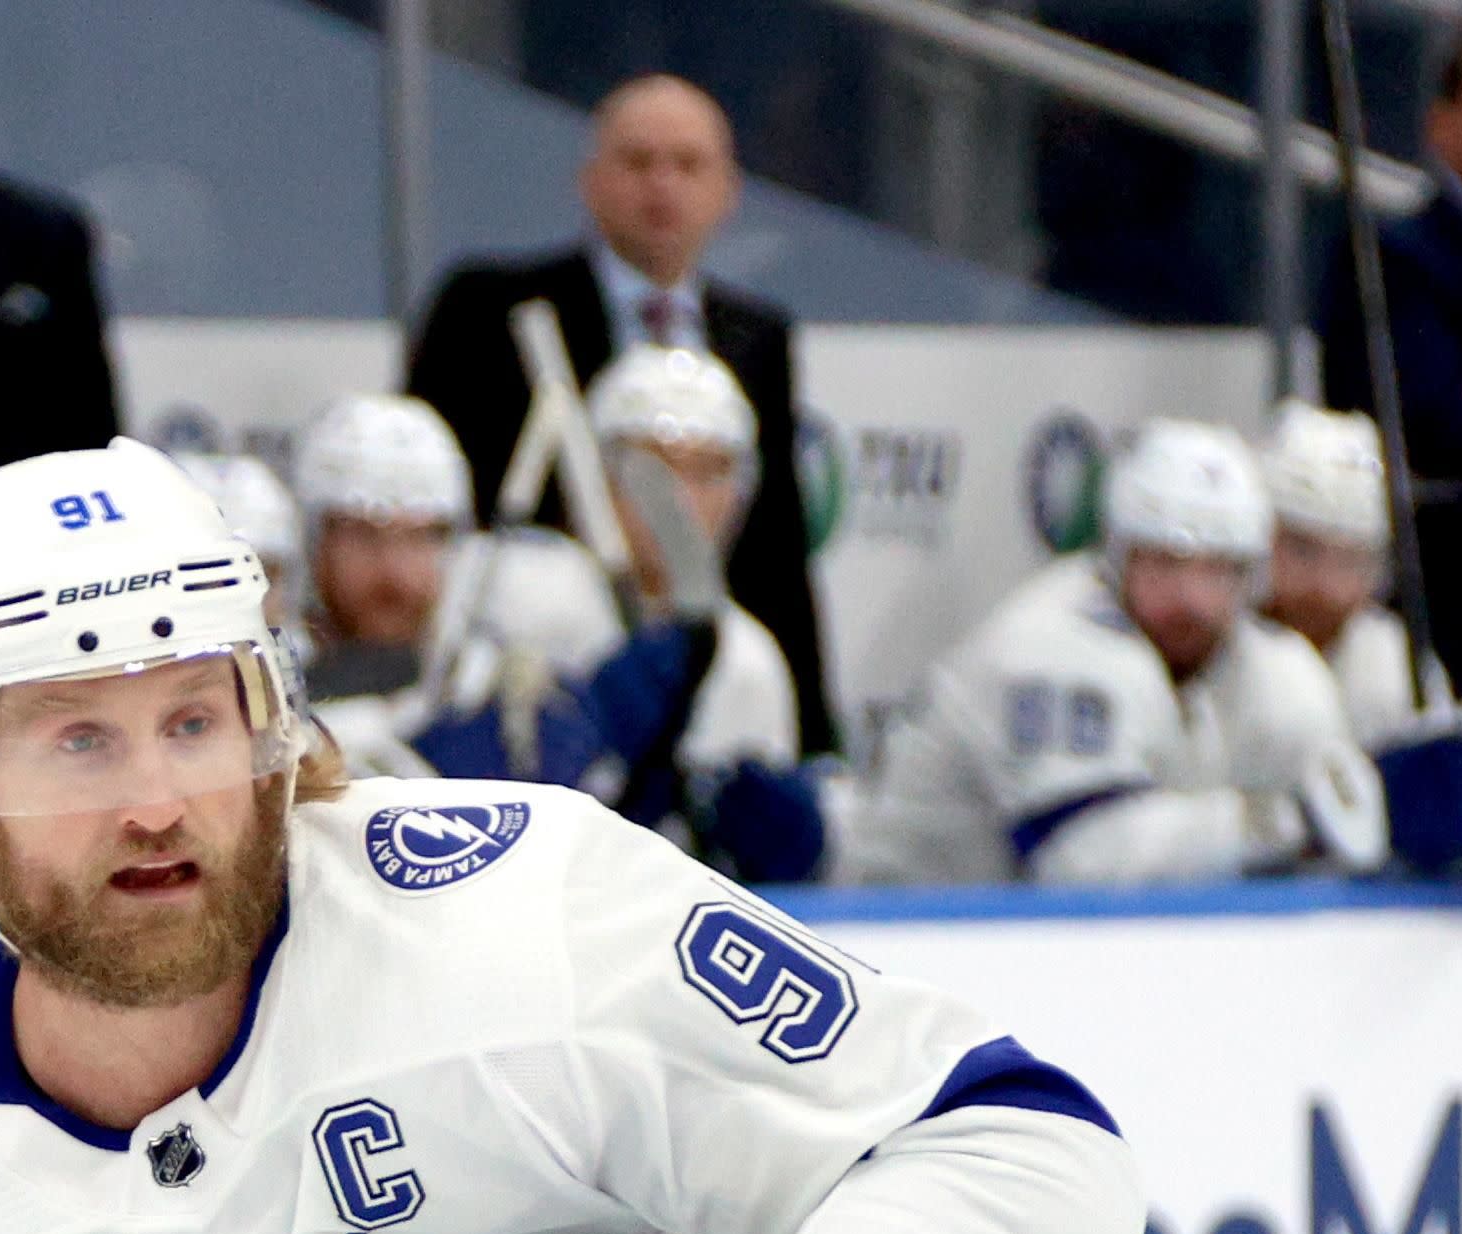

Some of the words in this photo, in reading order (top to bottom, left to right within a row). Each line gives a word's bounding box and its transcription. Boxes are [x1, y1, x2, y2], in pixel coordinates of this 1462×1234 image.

[50, 490, 126, 530] 91
[55, 570, 173, 605] BAUER
[372, 838, 403, 877] BAY
[403, 854, 487, 884] TAMPA
[674, 888, 870, 1064] 9
[312, 1098, 425, 1230] C
